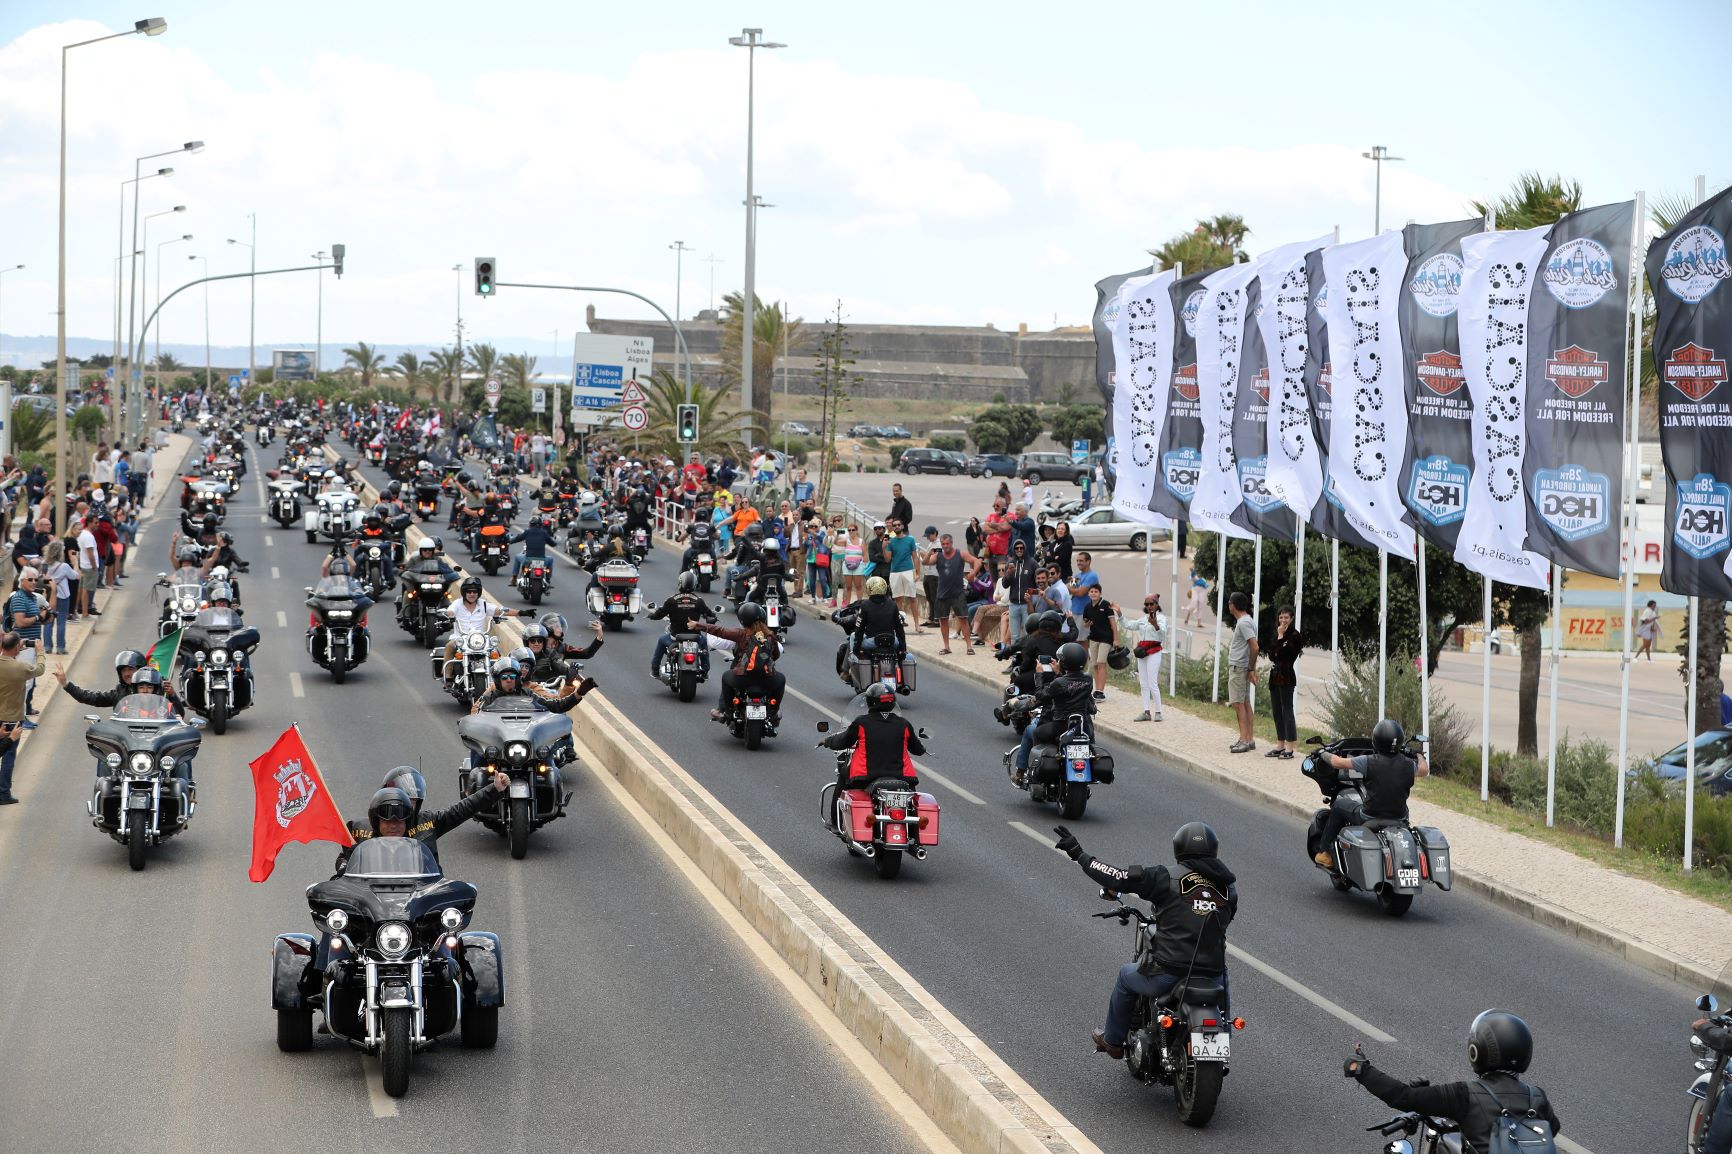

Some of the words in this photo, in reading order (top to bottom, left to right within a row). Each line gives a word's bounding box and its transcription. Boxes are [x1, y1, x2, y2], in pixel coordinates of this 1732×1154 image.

[626, 347, 650, 355] Lisboa
[595, 368, 619, 377] Lisboa
[592, 376, 622, 385] Cascais
[627, 413, 643, 424] 70
[1073, 440, 1081, 450] P
[1569, 618, 1605, 634] FIZZ
[1397, 868, 1420, 878] GD18
[1400, 877, 1419, 887] WTR
[1193, 899, 1217, 911] HOG
[1203, 1034, 1217, 1044] 54
